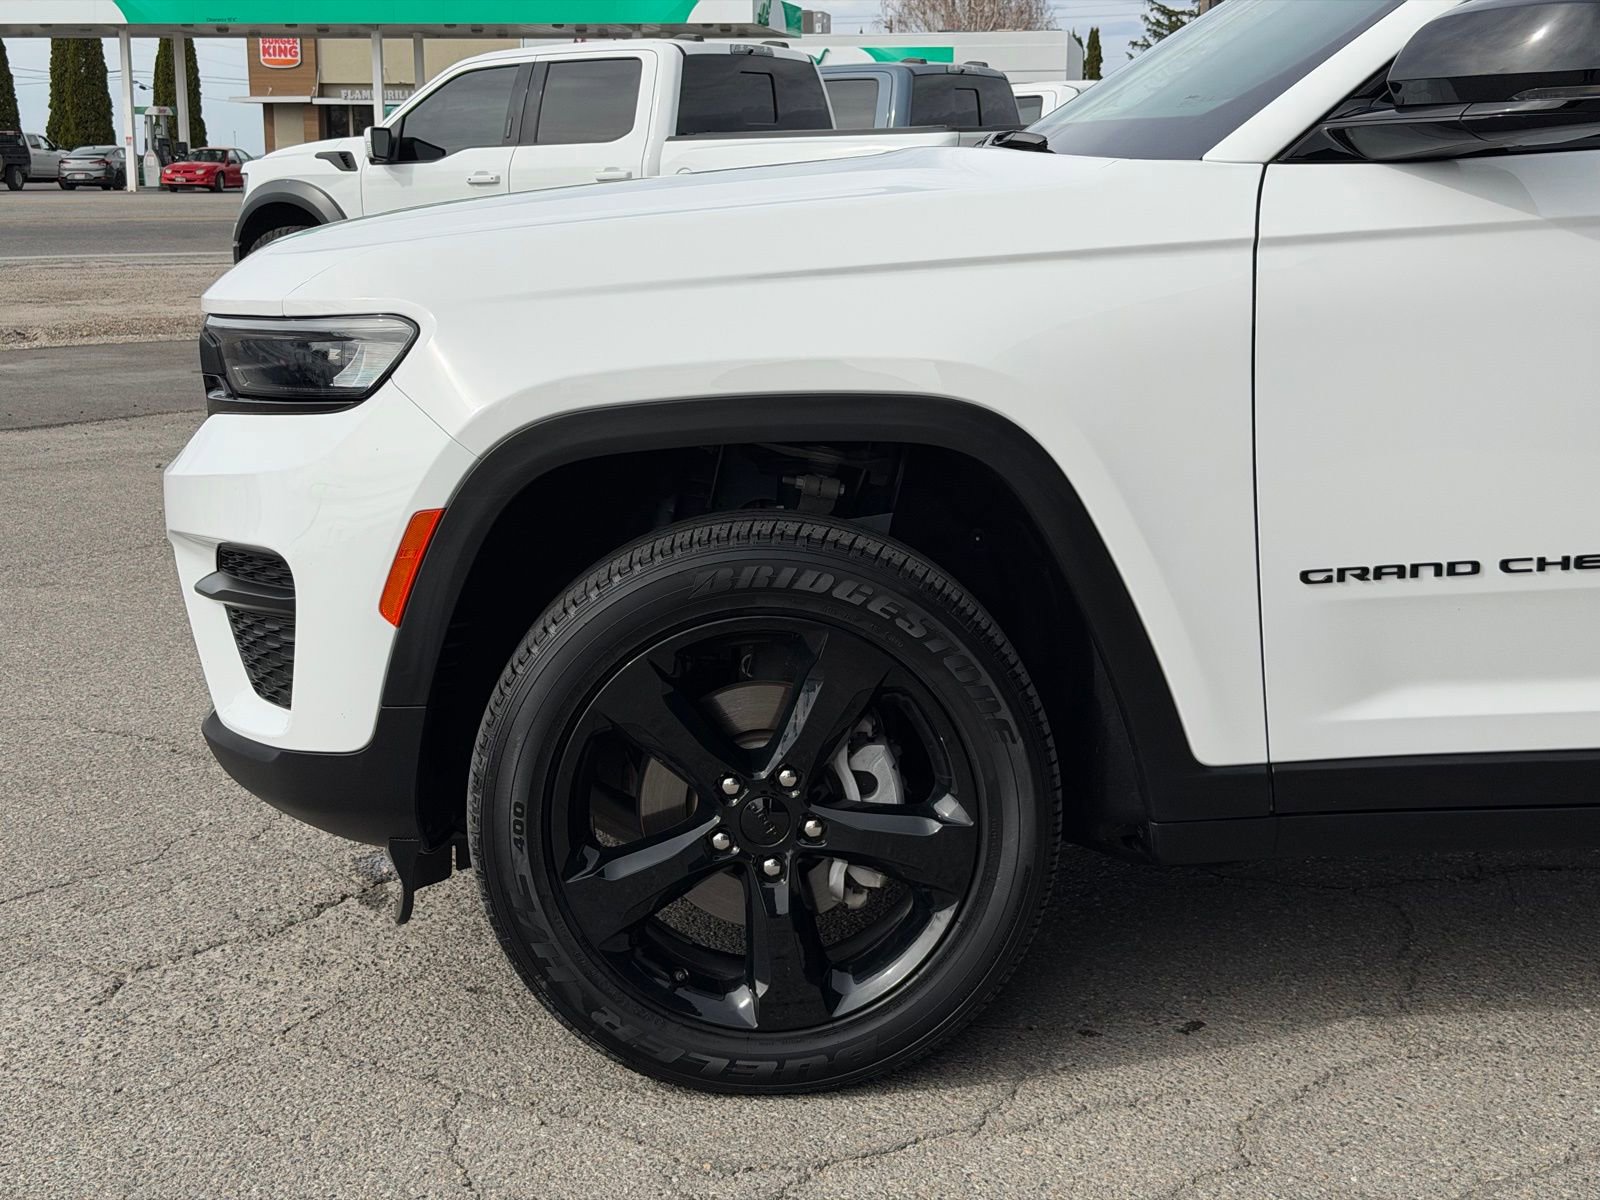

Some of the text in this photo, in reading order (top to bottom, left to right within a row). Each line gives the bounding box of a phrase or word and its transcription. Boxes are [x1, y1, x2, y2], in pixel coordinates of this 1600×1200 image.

[262, 37, 299, 45] BURGER
[262, 45, 299, 58] KING
[340, 89, 374, 100] FLAM
[1298, 560, 1482, 585] GRAND
[689, 565, 1020, 746] BRIDGESTONE
[512, 801, 526, 855] 400
[590, 1005, 881, 1080] DUELER
